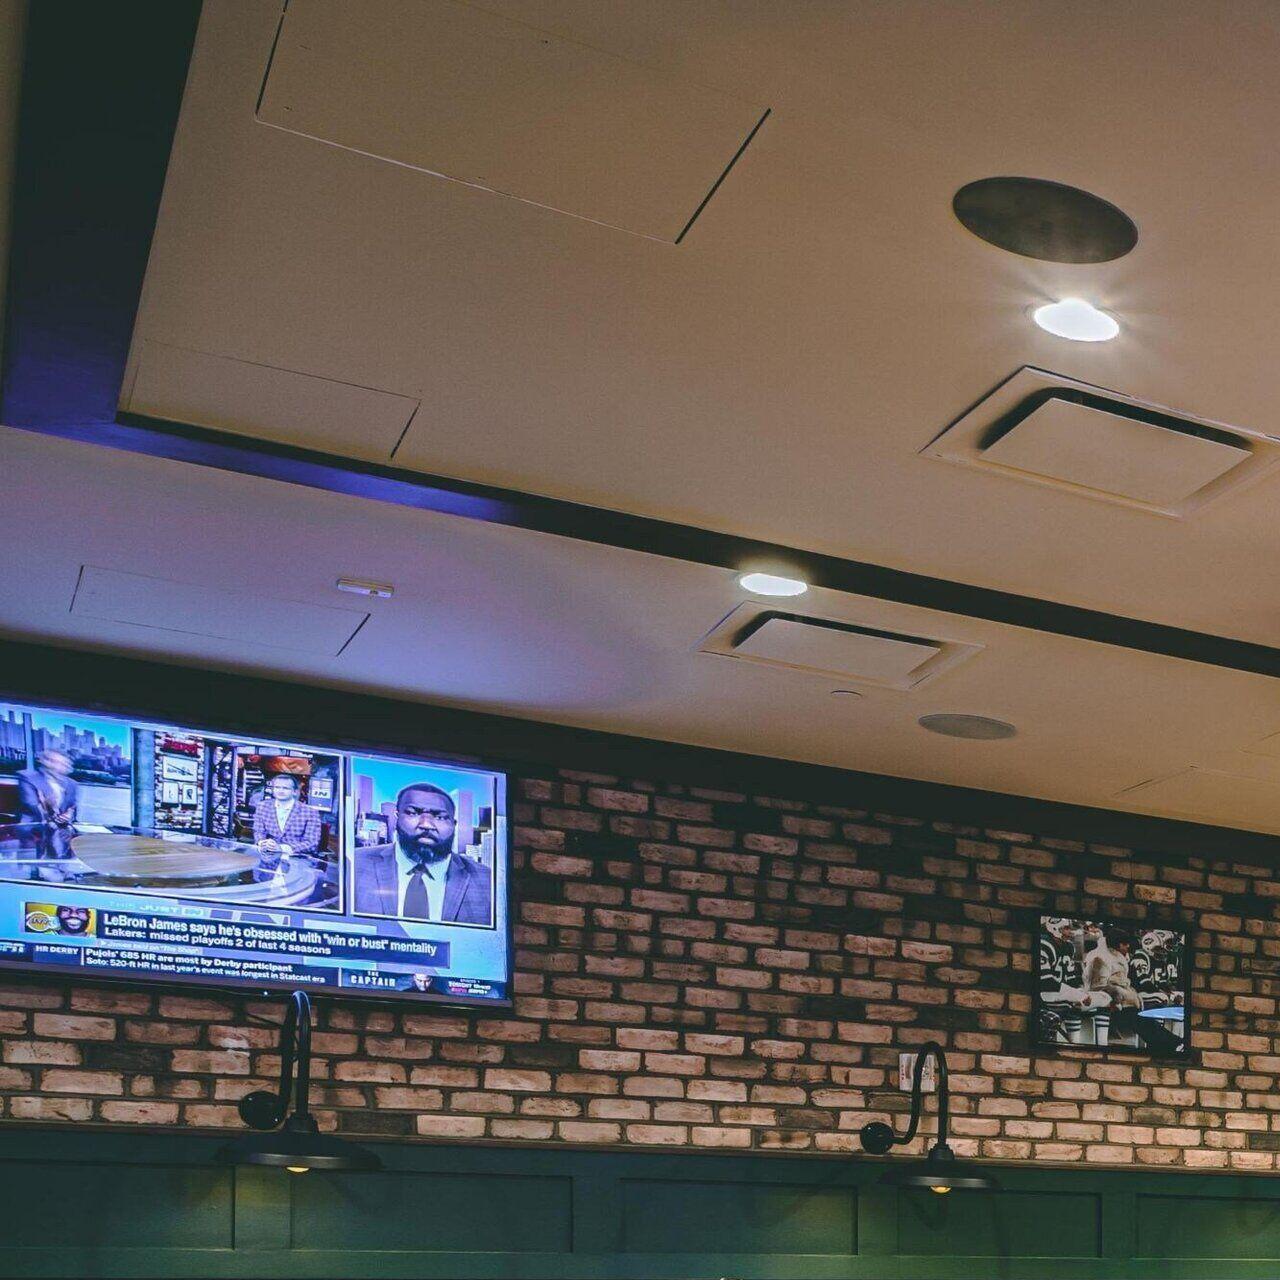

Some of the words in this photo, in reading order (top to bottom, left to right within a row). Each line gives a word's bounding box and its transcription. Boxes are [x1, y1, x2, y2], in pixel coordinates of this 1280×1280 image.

[103, 913, 147, 929] LeBron
[149, 917, 188, 932] James
[189, 923, 216, 936] says
[218, 924, 242, 937] he's
[243, 927, 297, 941] obsessed
[298, 932, 322, 944] with
[347, 938, 360, 948] or
[390, 941, 438, 957] mentality
[104, 927, 147, 939] Lakers:
[149, 931, 189, 943] missed
[191, 934, 234, 947] playoffs
[235, 938, 244, 948] 2
[245, 939, 257, 948] of
[258, 940, 278, 950] last
[279, 941, 287, 951] 4
[288, 945, 331, 955] seasons
[49, 946, 79, 955] DERBY
[120, 950, 140, 960] 685
[141, 953, 156, 961] HR
[175, 956, 200, 965] most
[201, 957, 213, 966] by
[214, 958, 242, 969] Derby
[243, 961, 293, 972] participant
[85, 957, 109, 966] Soto:
[110, 959, 136, 969] 520-ft
[151, 962, 160, 970] in
[160, 963, 176, 971] last
[202, 967, 224, 975] event
[224, 969, 240, 977] was
[241, 970, 270, 979] longest
[279, 972, 311, 982] Statcast
